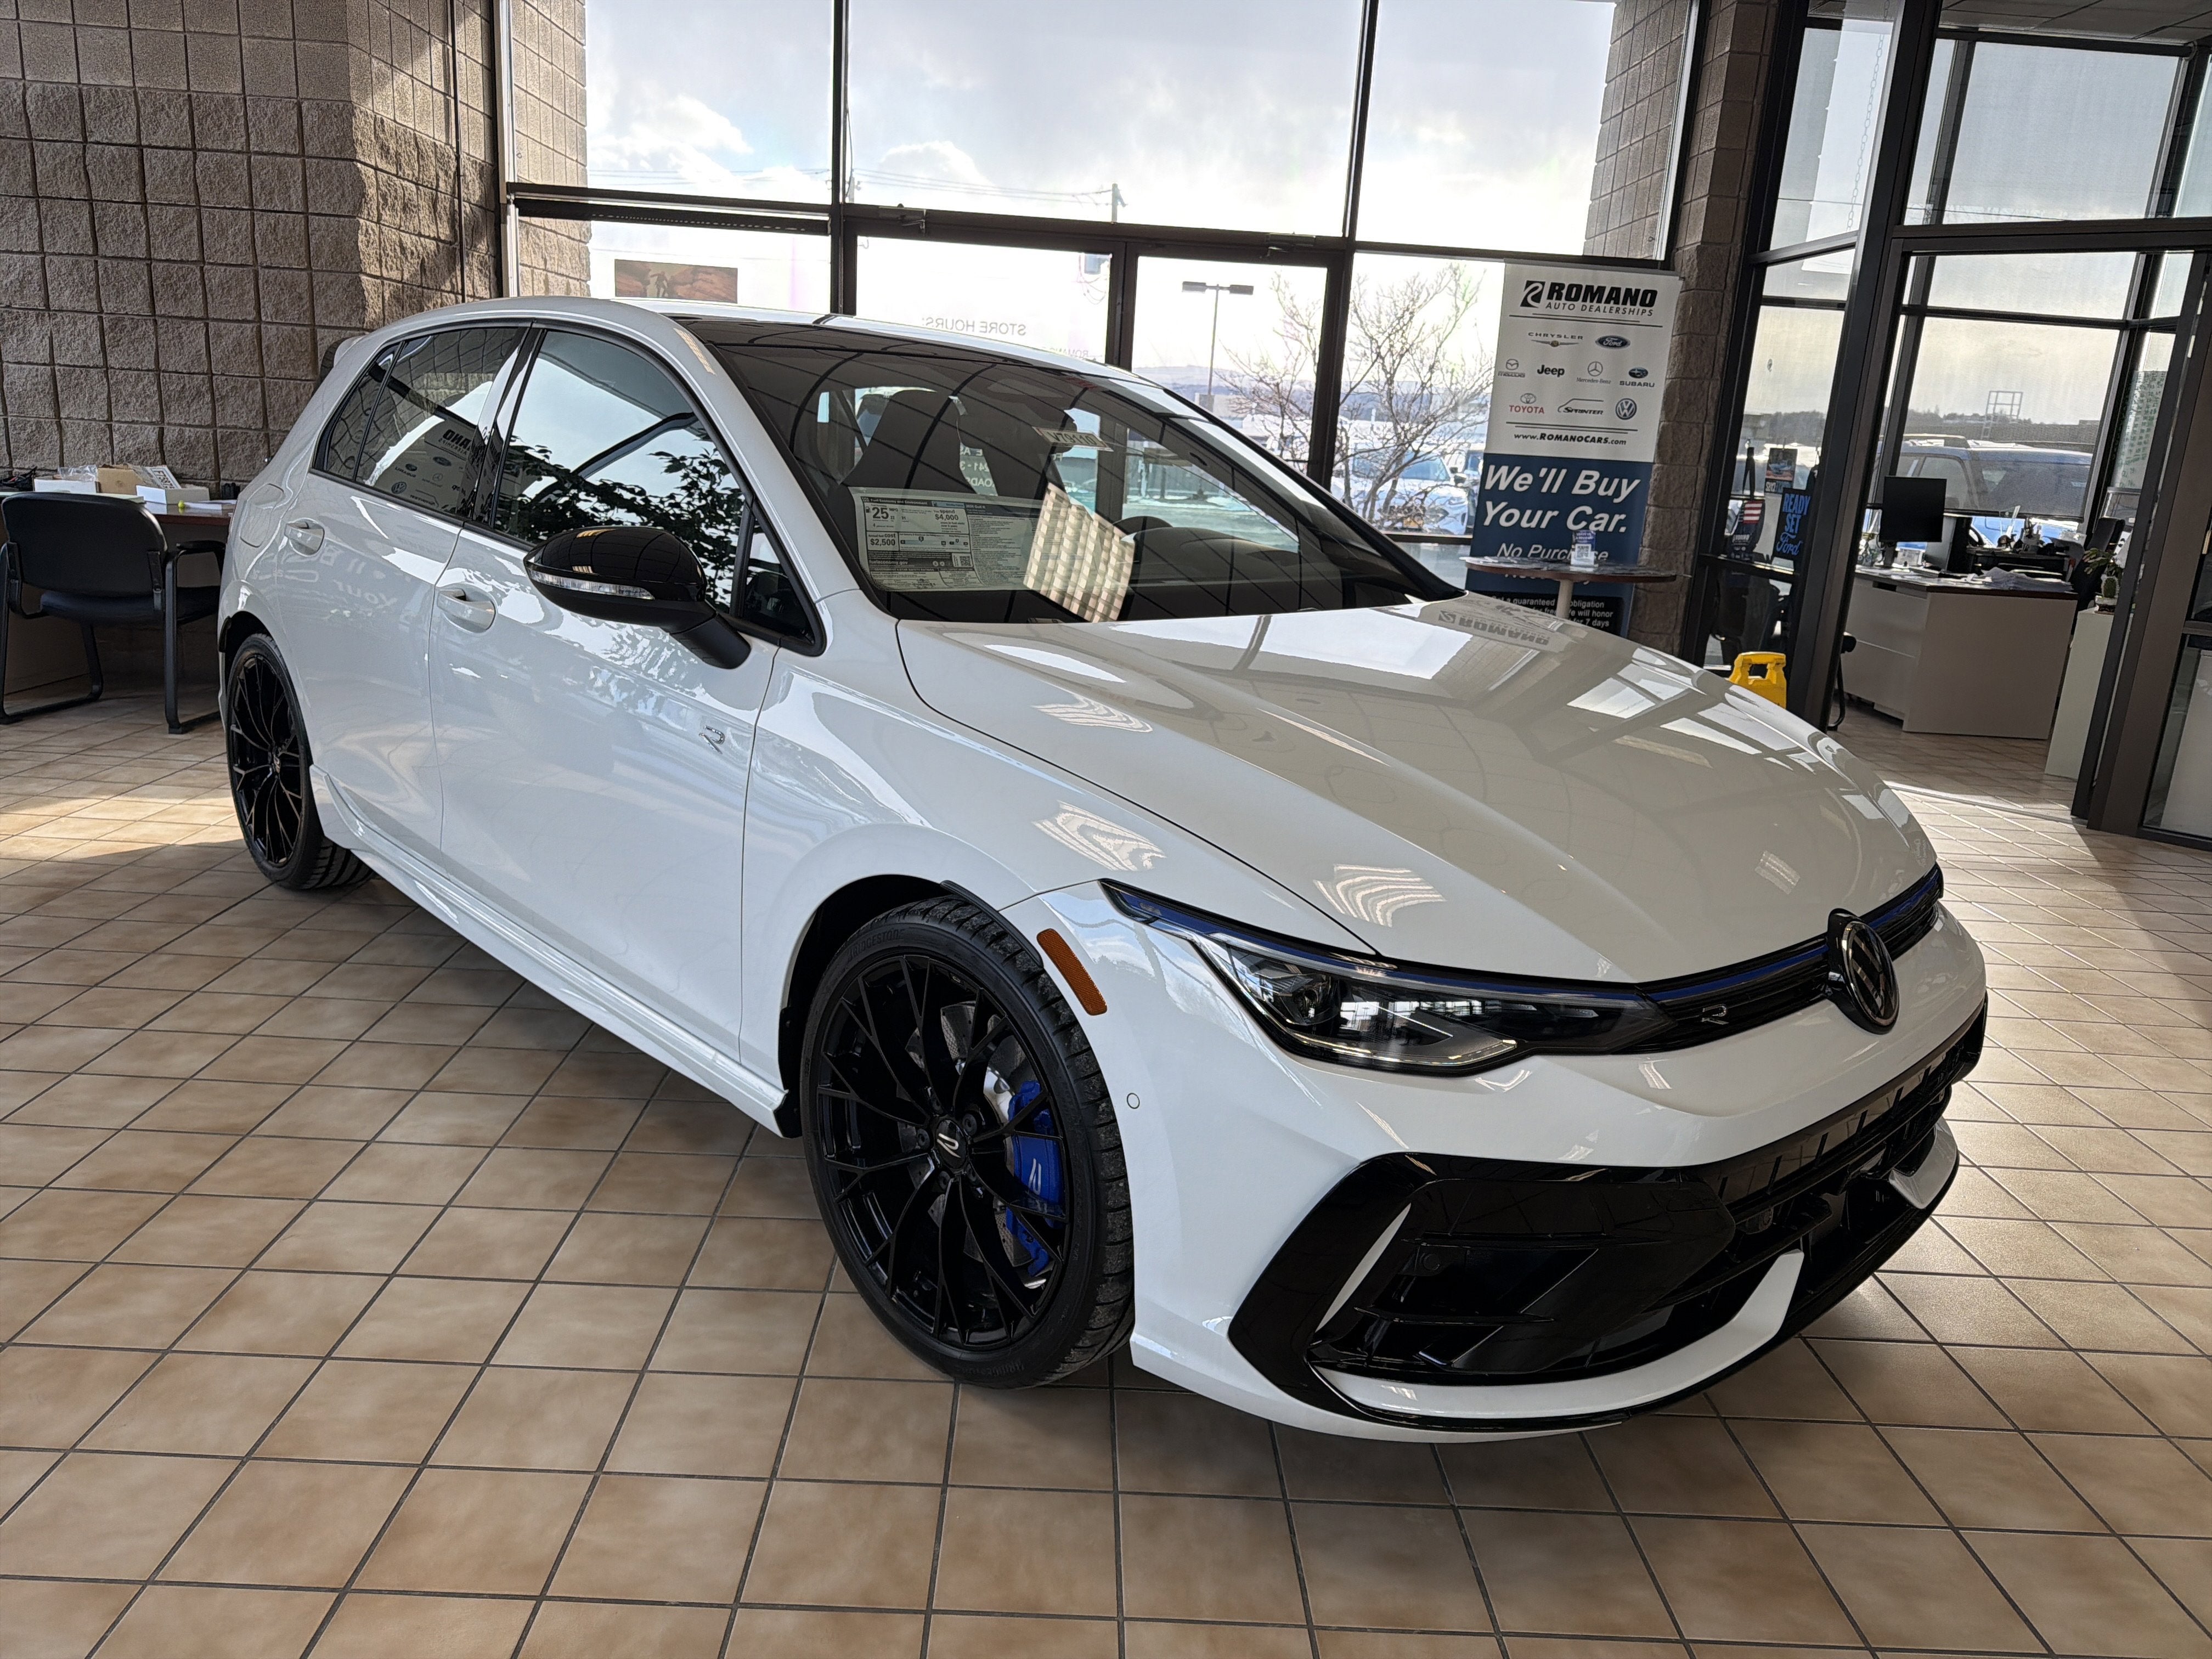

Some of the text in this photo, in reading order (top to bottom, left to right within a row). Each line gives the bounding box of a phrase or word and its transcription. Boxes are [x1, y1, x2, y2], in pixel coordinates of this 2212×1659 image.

[1547, 282, 1658, 308] ROMANO
[1545, 302, 1654, 317] AUTO DEALERSHIPS
[1528, 332, 1584, 340] CHRYSLER
[1537, 364, 1565, 377] Jeep
[1509, 405, 1545, 414] TOYOTA
[1485, 465, 1640, 504] We'll Buy
[1783, 493, 1811, 516] READY
[872, 506, 889, 520] 25
[1483, 500, 1627, 533] Your Car.
[1785, 514, 1802, 534] SET
[870, 538, 896, 546] $2,500
[1776, 531, 1804, 556] Ford
[1497, 543, 1609, 561] No Purcse
[1513, 598, 1556, 606] guaranteed
[1592, 610, 1614, 618] honor
[1592, 618, 1610, 628] days
